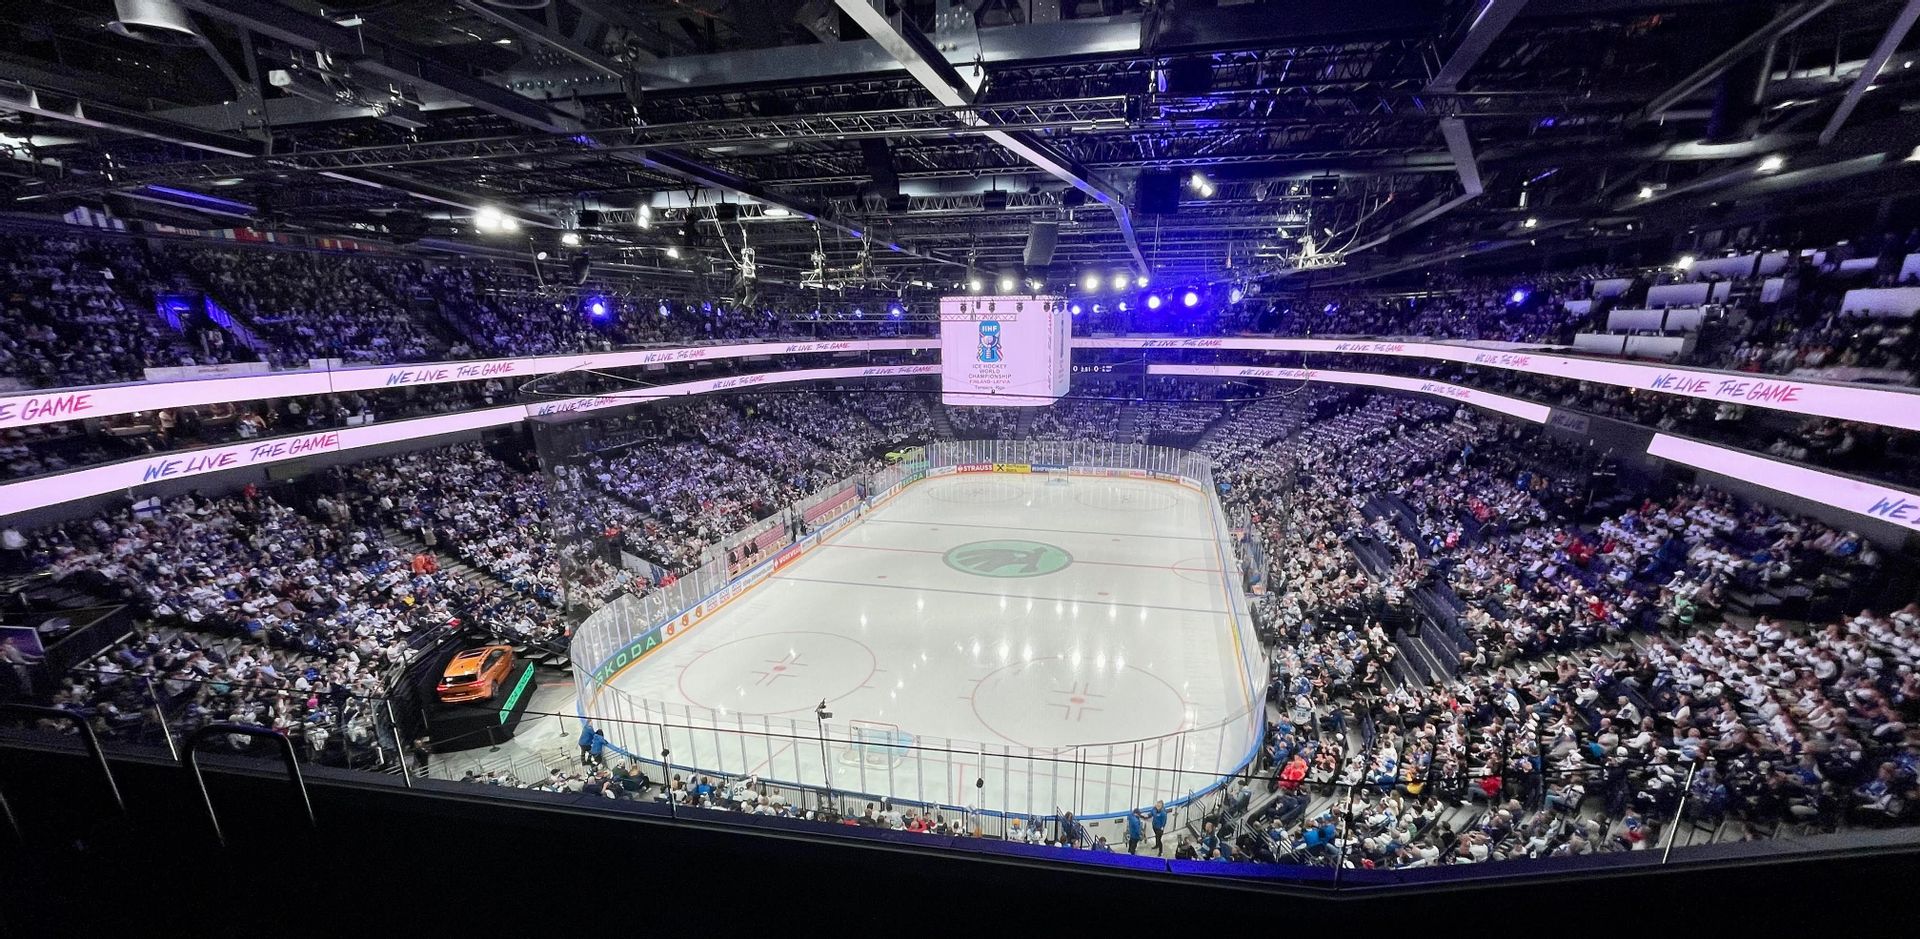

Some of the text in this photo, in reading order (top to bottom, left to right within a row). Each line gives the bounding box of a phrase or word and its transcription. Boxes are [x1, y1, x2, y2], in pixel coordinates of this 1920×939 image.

[786, 345, 798, 353] WE
[797, 344, 812, 352] LIVE
[386, 362, 515, 386] WE LIVE THE GAME
[1651, 373, 1803, 402] WE LIVE THE GAME
[21, 394, 93, 420] GAME
[143, 434, 339, 482] WE LIVE THE GAME
[963, 464, 993, 472] STRAUSS
[1867, 497, 1919, 519] WE
